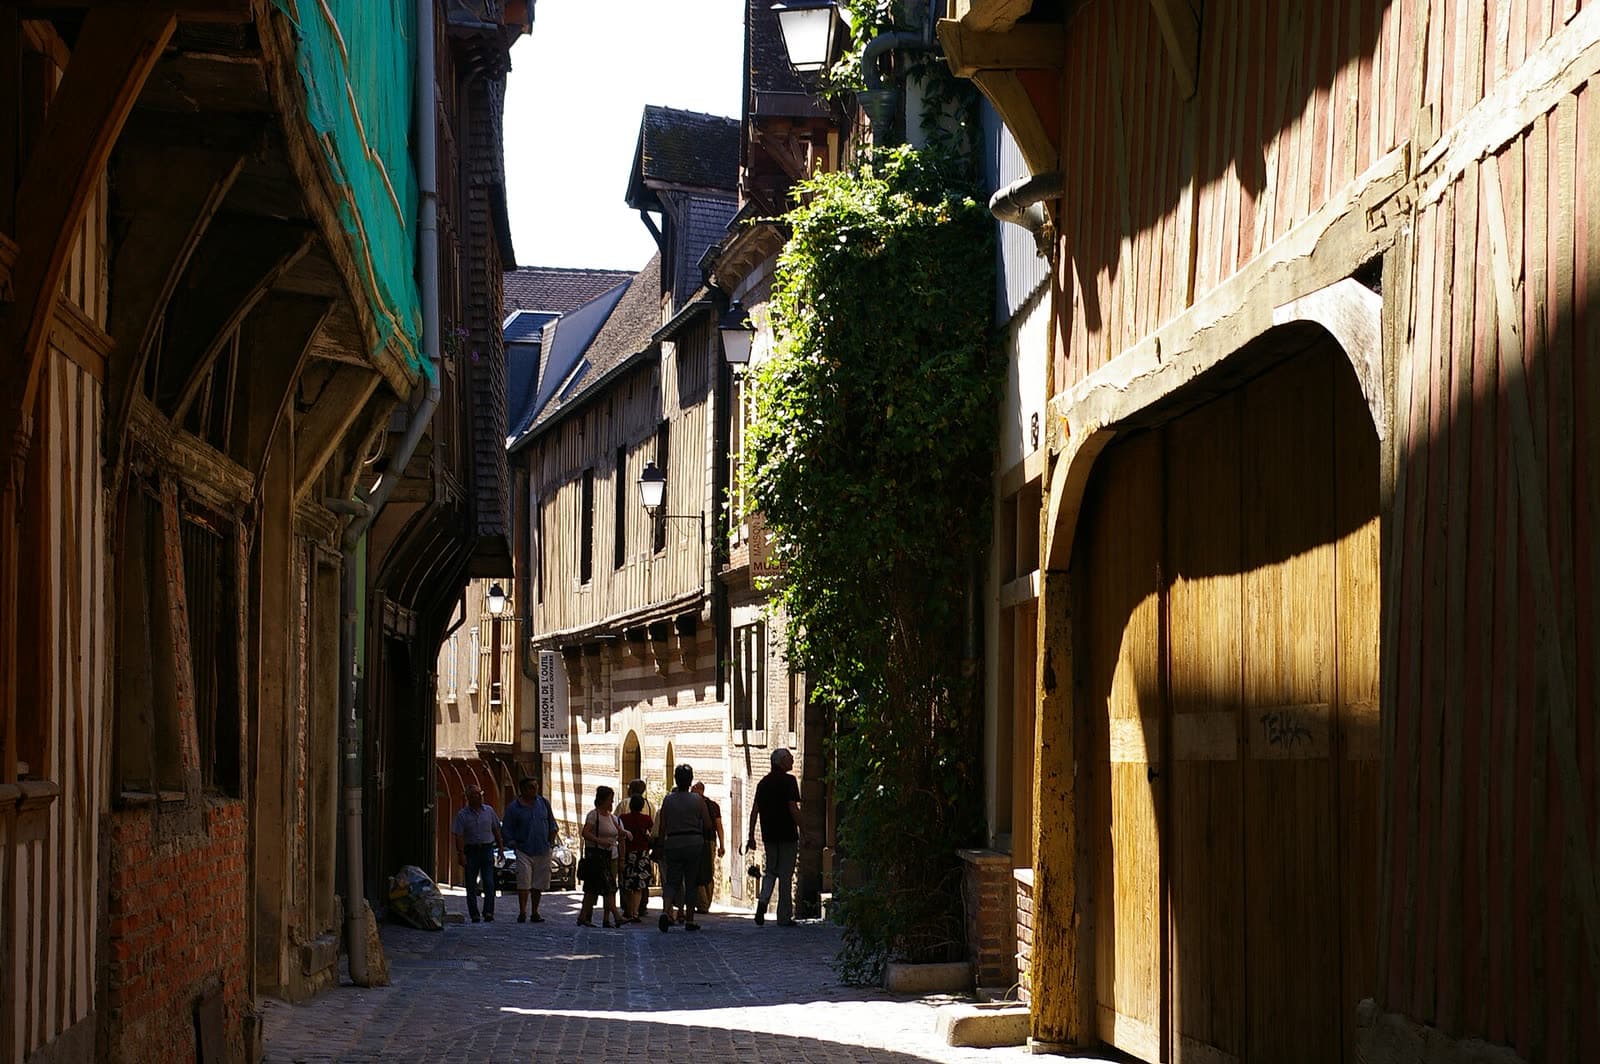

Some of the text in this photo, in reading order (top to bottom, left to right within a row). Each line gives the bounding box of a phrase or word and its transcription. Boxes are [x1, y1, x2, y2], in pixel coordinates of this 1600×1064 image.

[541, 655, 549, 730] MAISON DE L'OUTIL
